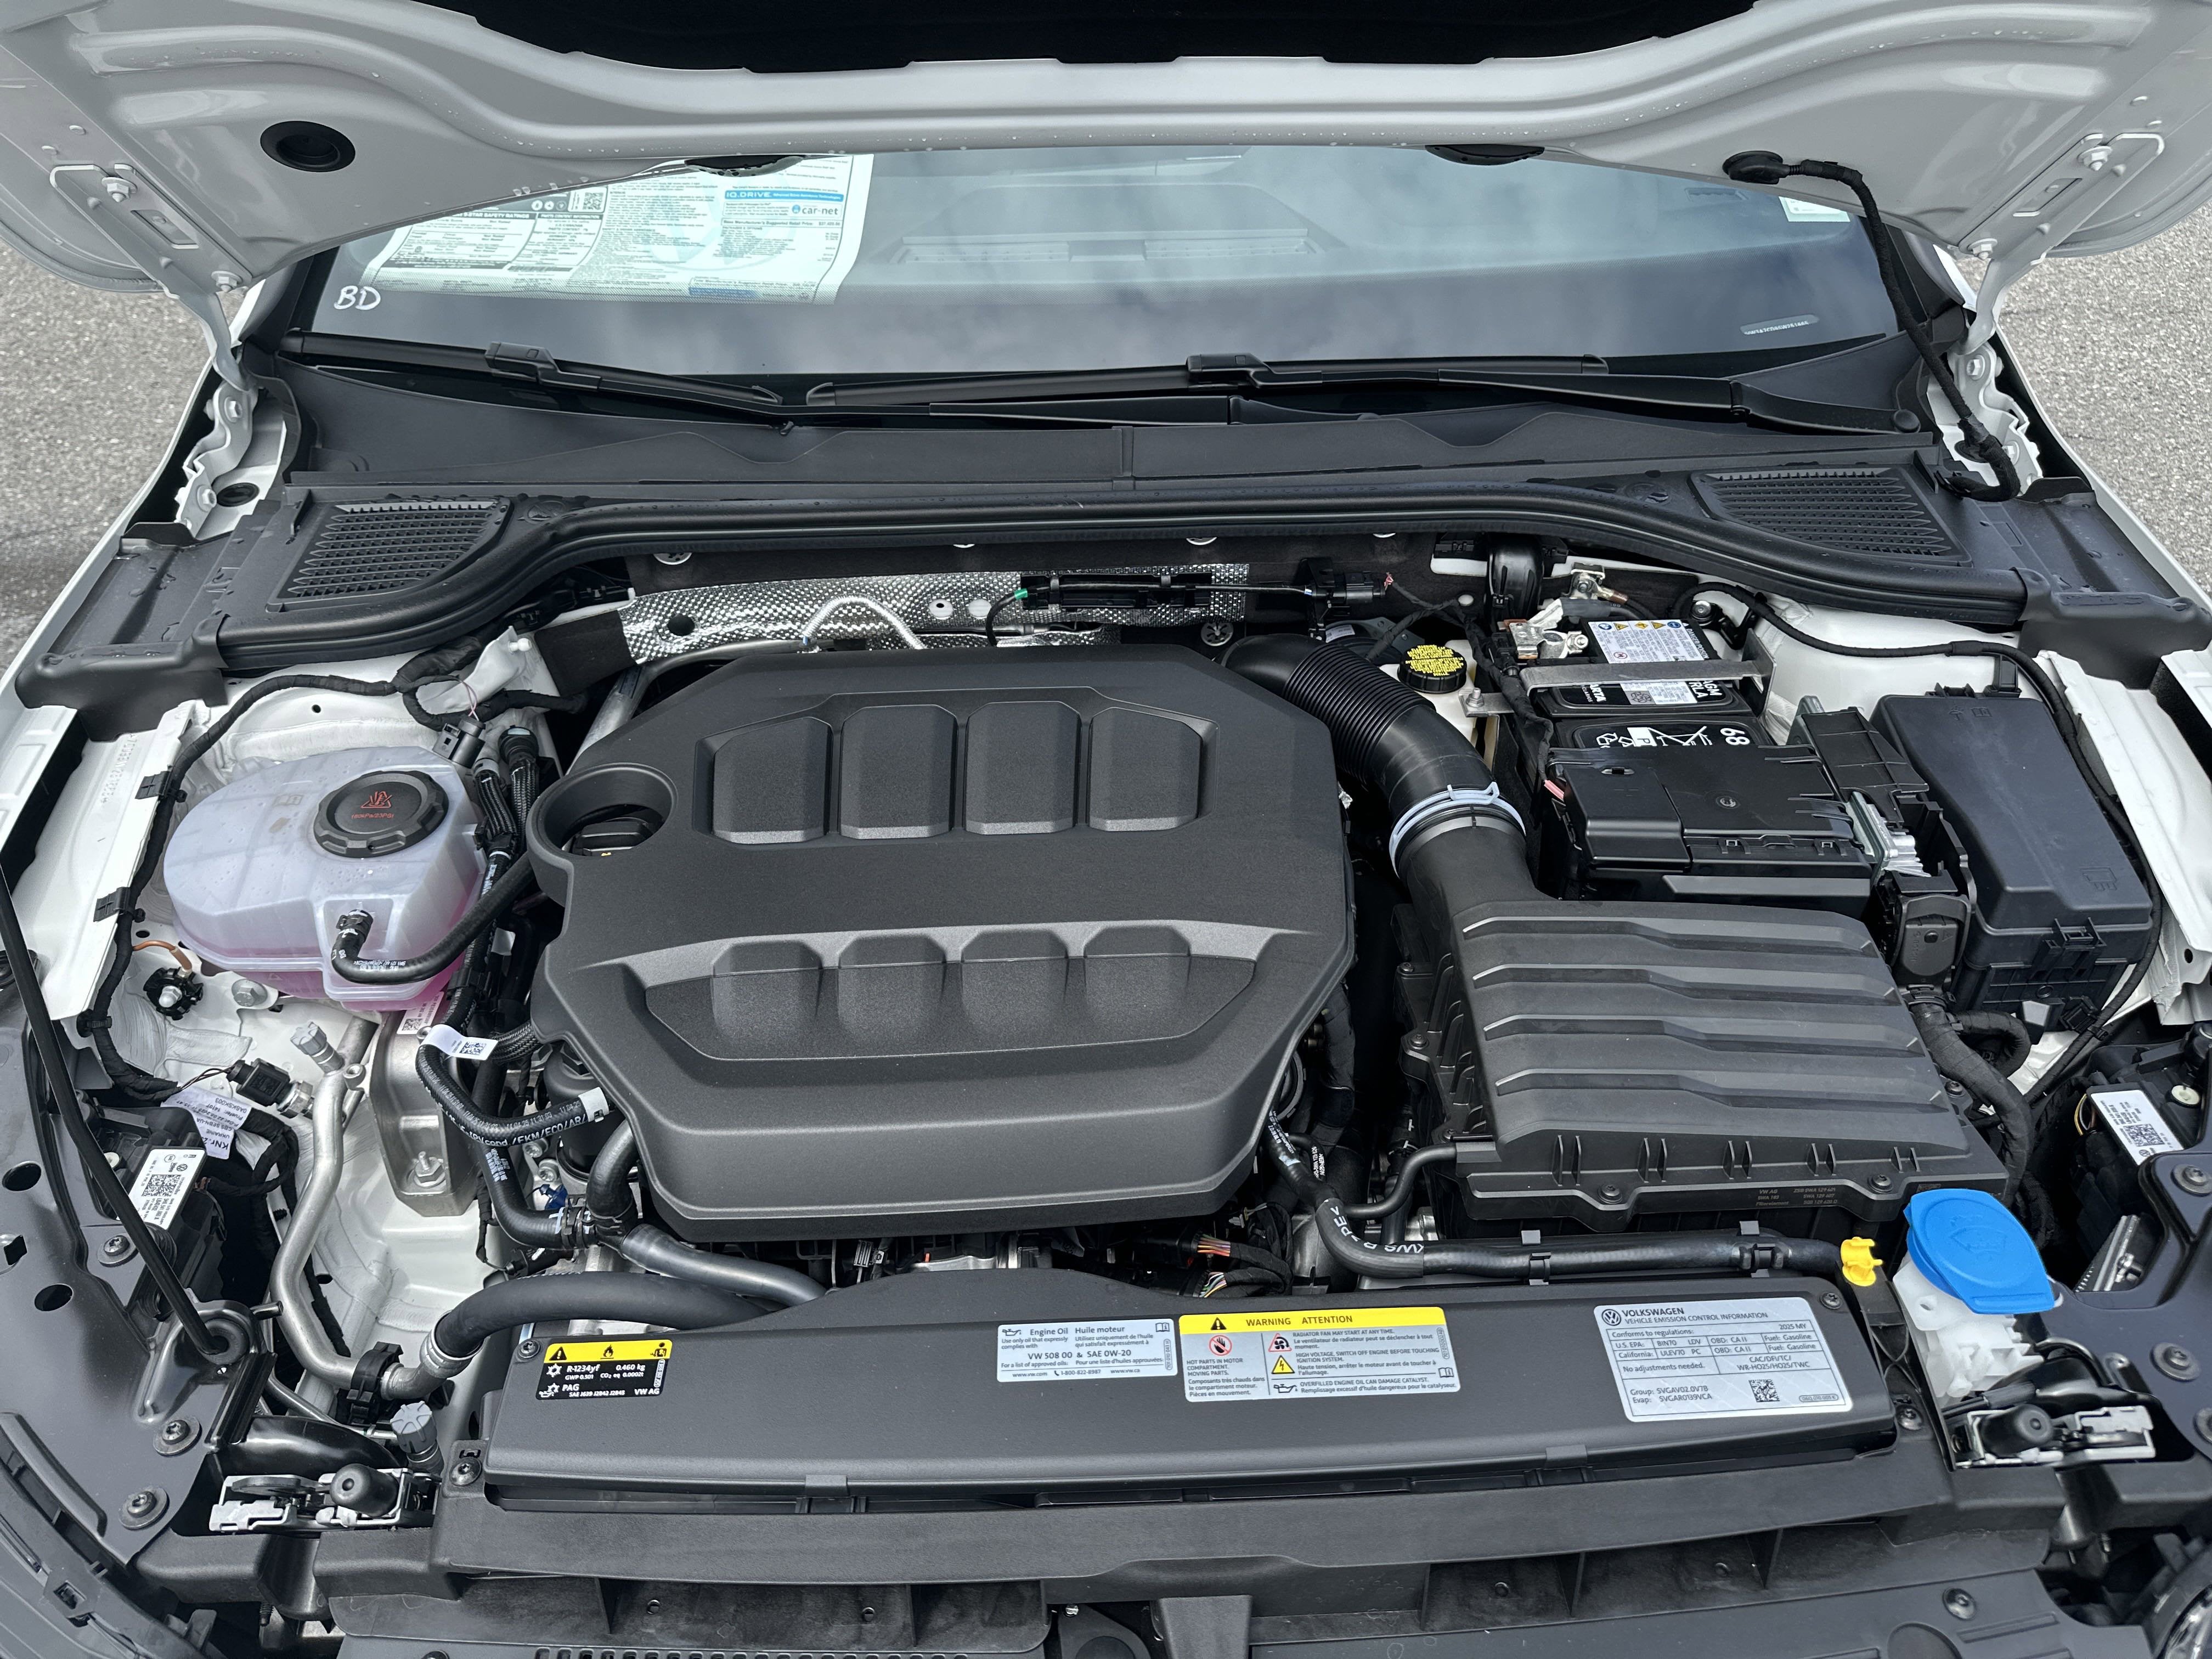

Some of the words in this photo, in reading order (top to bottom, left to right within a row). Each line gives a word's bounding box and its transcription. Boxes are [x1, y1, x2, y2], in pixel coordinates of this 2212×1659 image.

[802, 207, 838, 215] car-net
[334, 285, 381, 310] BD
[1590, 685, 1606, 702] ARTA
[1689, 682, 1707, 698] RLA
[206, 1129, 230, 1138] UKRAINE
[1622, 1308, 1685, 1317] VOLKSWAGEN
[1246, 1318, 1291, 1326] WARNING
[1302, 1316, 1353, 1324] ATTENTION
[567, 1364, 600, 1373] R-1234yf
